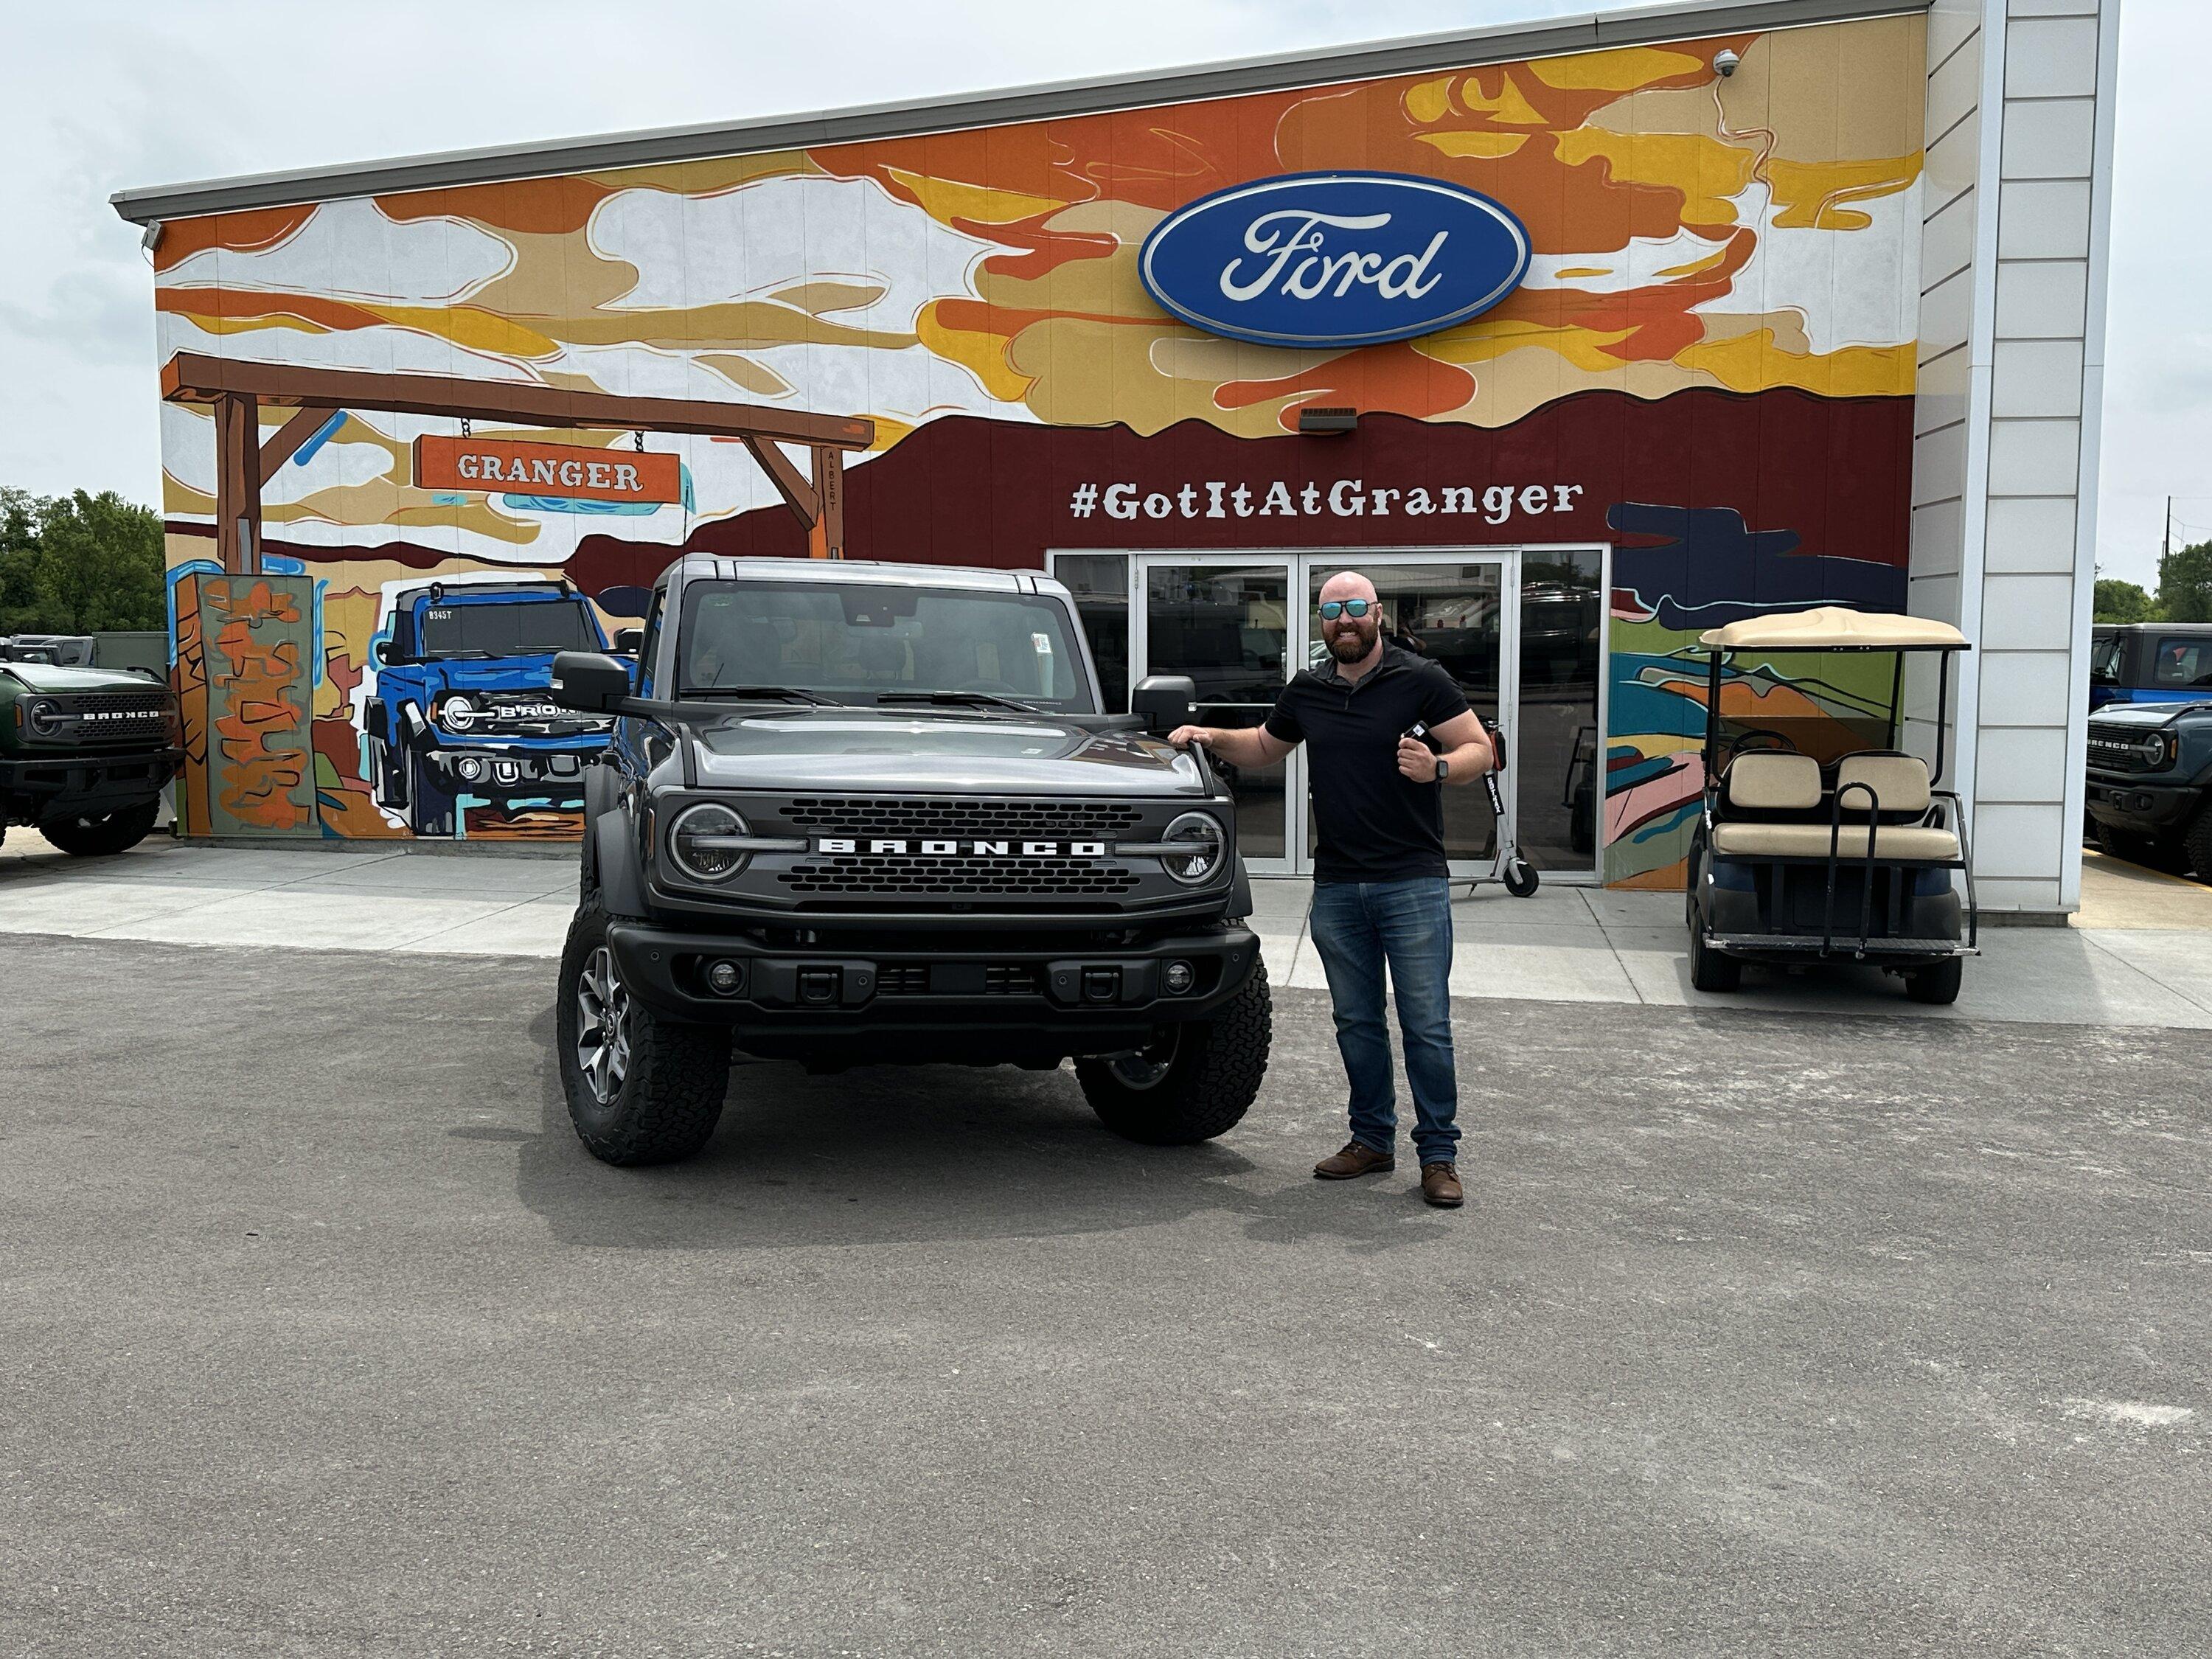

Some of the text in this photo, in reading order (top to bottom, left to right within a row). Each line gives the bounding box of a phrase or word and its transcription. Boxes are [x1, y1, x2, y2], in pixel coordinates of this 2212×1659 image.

[1220, 210, 1448, 301] Ford
[458, 454, 644, 492] GRANGER
[828, 451, 836, 511] ALBERT
[1070, 479, 1584, 524] #GotItAtGranger
[83, 711, 159, 720] BRONCO
[818, 838, 1105, 856] BRONCO
